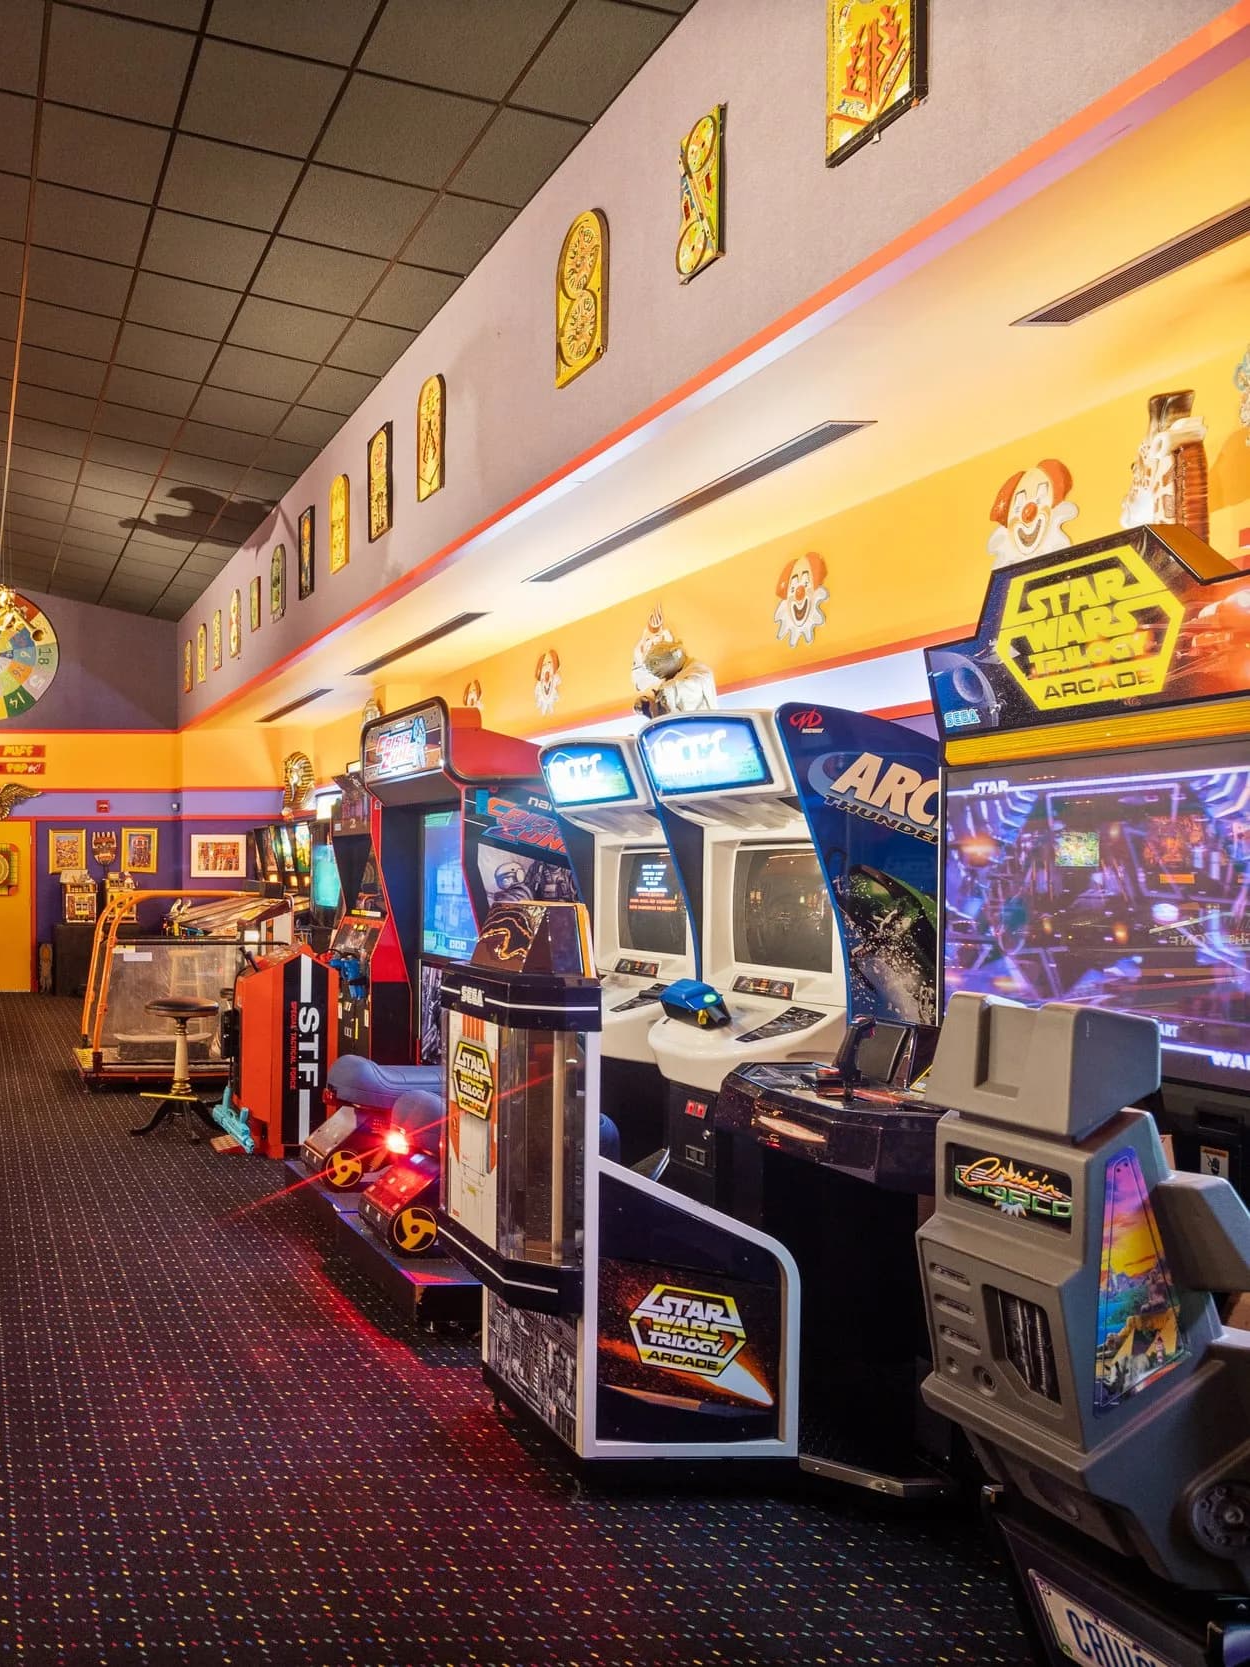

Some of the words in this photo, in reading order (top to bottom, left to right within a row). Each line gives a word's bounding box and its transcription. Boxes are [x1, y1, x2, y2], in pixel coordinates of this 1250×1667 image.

[1020, 566, 1141, 617] STAR
[1023, 604, 1139, 652] WARS
[38, 648, 52, 665] 18
[1028, 632, 1149, 675] TRILOGY
[1044, 671, 1155, 700] ARCADE
[9, 692, 25, 708] 14
[943, 708, 981, 728] SEGA
[376, 734, 411, 755] CRISIS
[830, 752, 939, 831] ARC
[973, 780, 1010, 794] STAR
[528, 797, 553, 811] na
[461, 985, 484, 1007] SEGA
[459, 1051, 489, 1075] STAR
[460, 1081, 486, 1100] TRILOGY
[652, 1295, 731, 1322] STAR
[652, 1312, 721, 1341] WARS
[648, 1330, 724, 1354] TRILOGY
[647, 1350, 719, 1371] ARCADE
